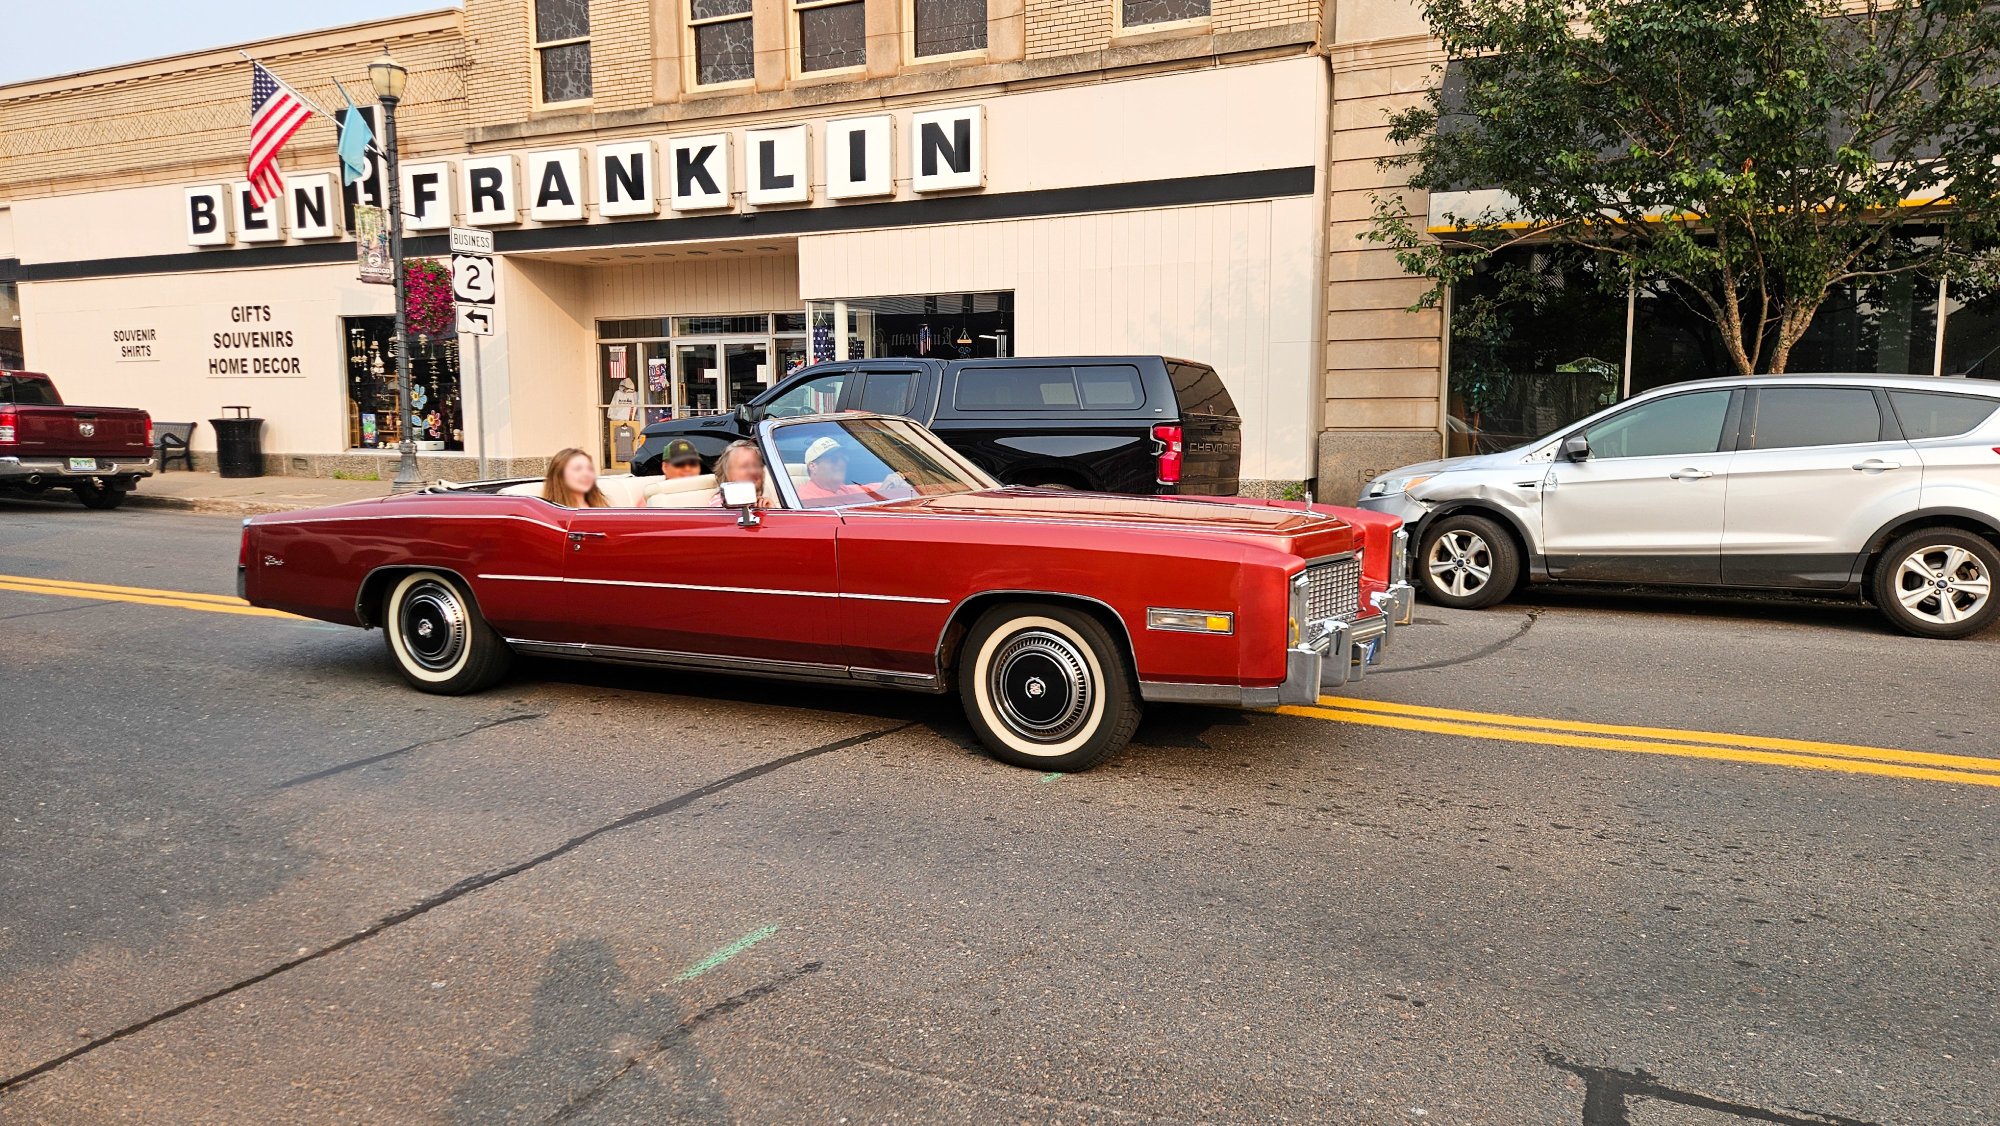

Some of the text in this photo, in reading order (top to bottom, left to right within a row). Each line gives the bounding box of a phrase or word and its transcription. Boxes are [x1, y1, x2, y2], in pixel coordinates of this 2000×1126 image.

[190, 118, 971, 235] BEN FRANKLIN
[453, 233, 490, 248] BUSINESS
[466, 265, 481, 290] 2
[231, 305, 271, 322] GIFTS
[113, 329, 156, 342] SOUVENIR
[213, 331, 294, 348] SOUVENIRS
[121, 345, 152, 357] SHIRTS
[209, 357, 301, 374] HOME DECOR
[649, 364, 667, 377] USA
[1357, 468, 1390, 483] 19
